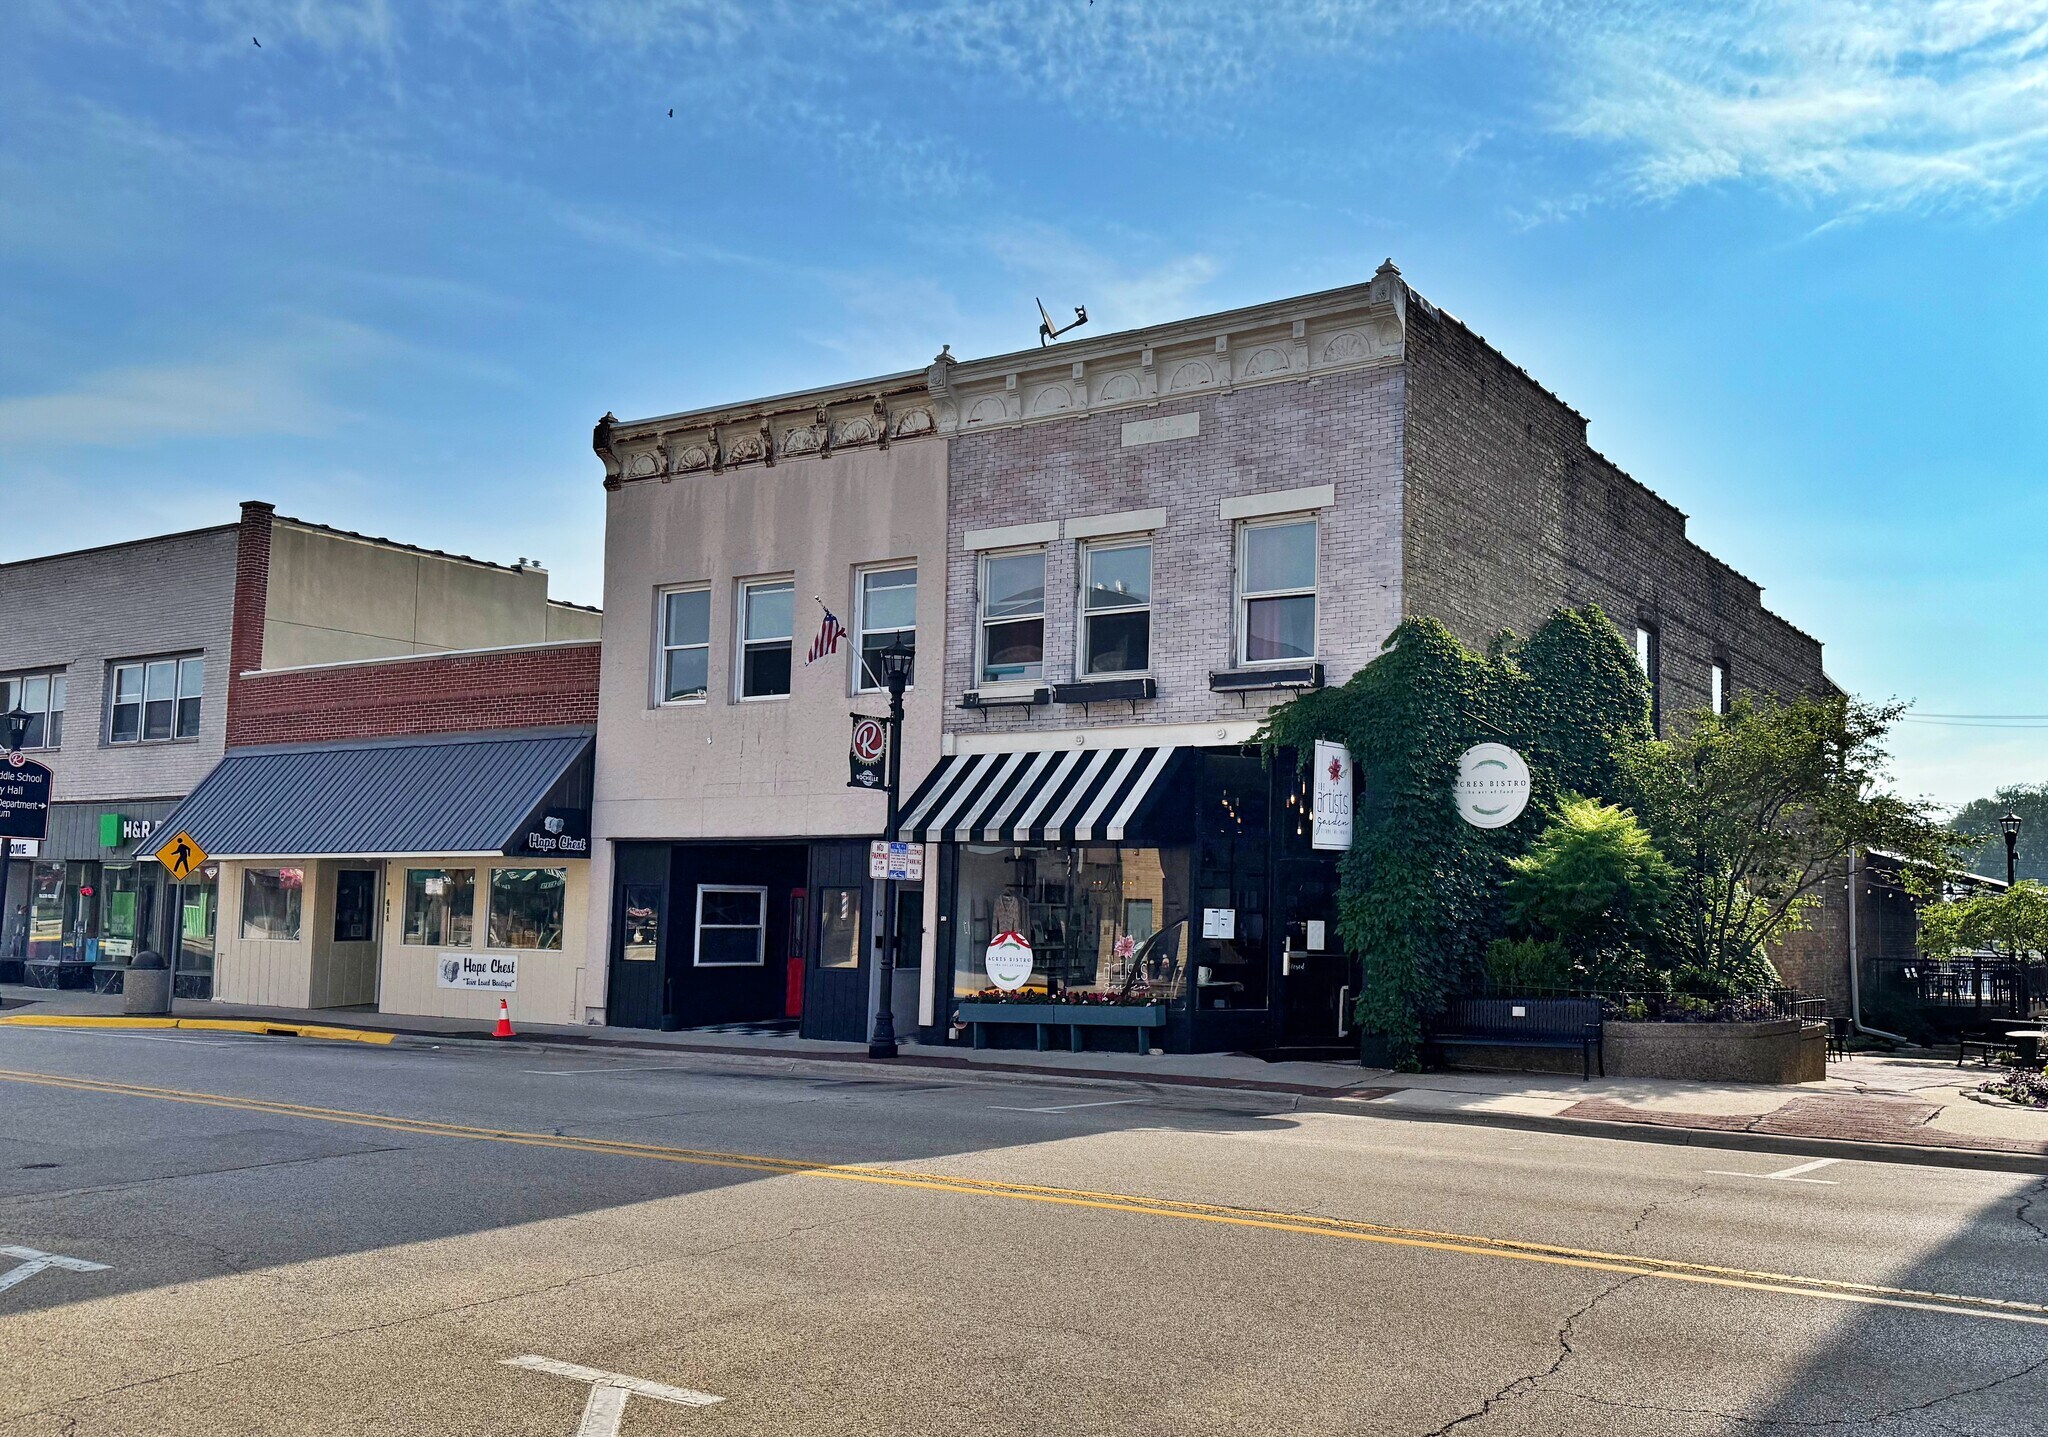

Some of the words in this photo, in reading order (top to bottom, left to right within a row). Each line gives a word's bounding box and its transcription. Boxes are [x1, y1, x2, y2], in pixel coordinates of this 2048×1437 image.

[857, 723, 881, 757] R
[16, 772, 42, 784] School
[8, 785, 24, 795] Hall
[0, 798, 38, 810] Department
[123, 820, 150, 838] H&R
[1316, 814, 1350, 836] garden
[529, 832, 556, 852] Hope
[558, 835, 586, 850] Chest
[464, 958, 486, 976] Hope
[490, 959, 514, 974] Chest
